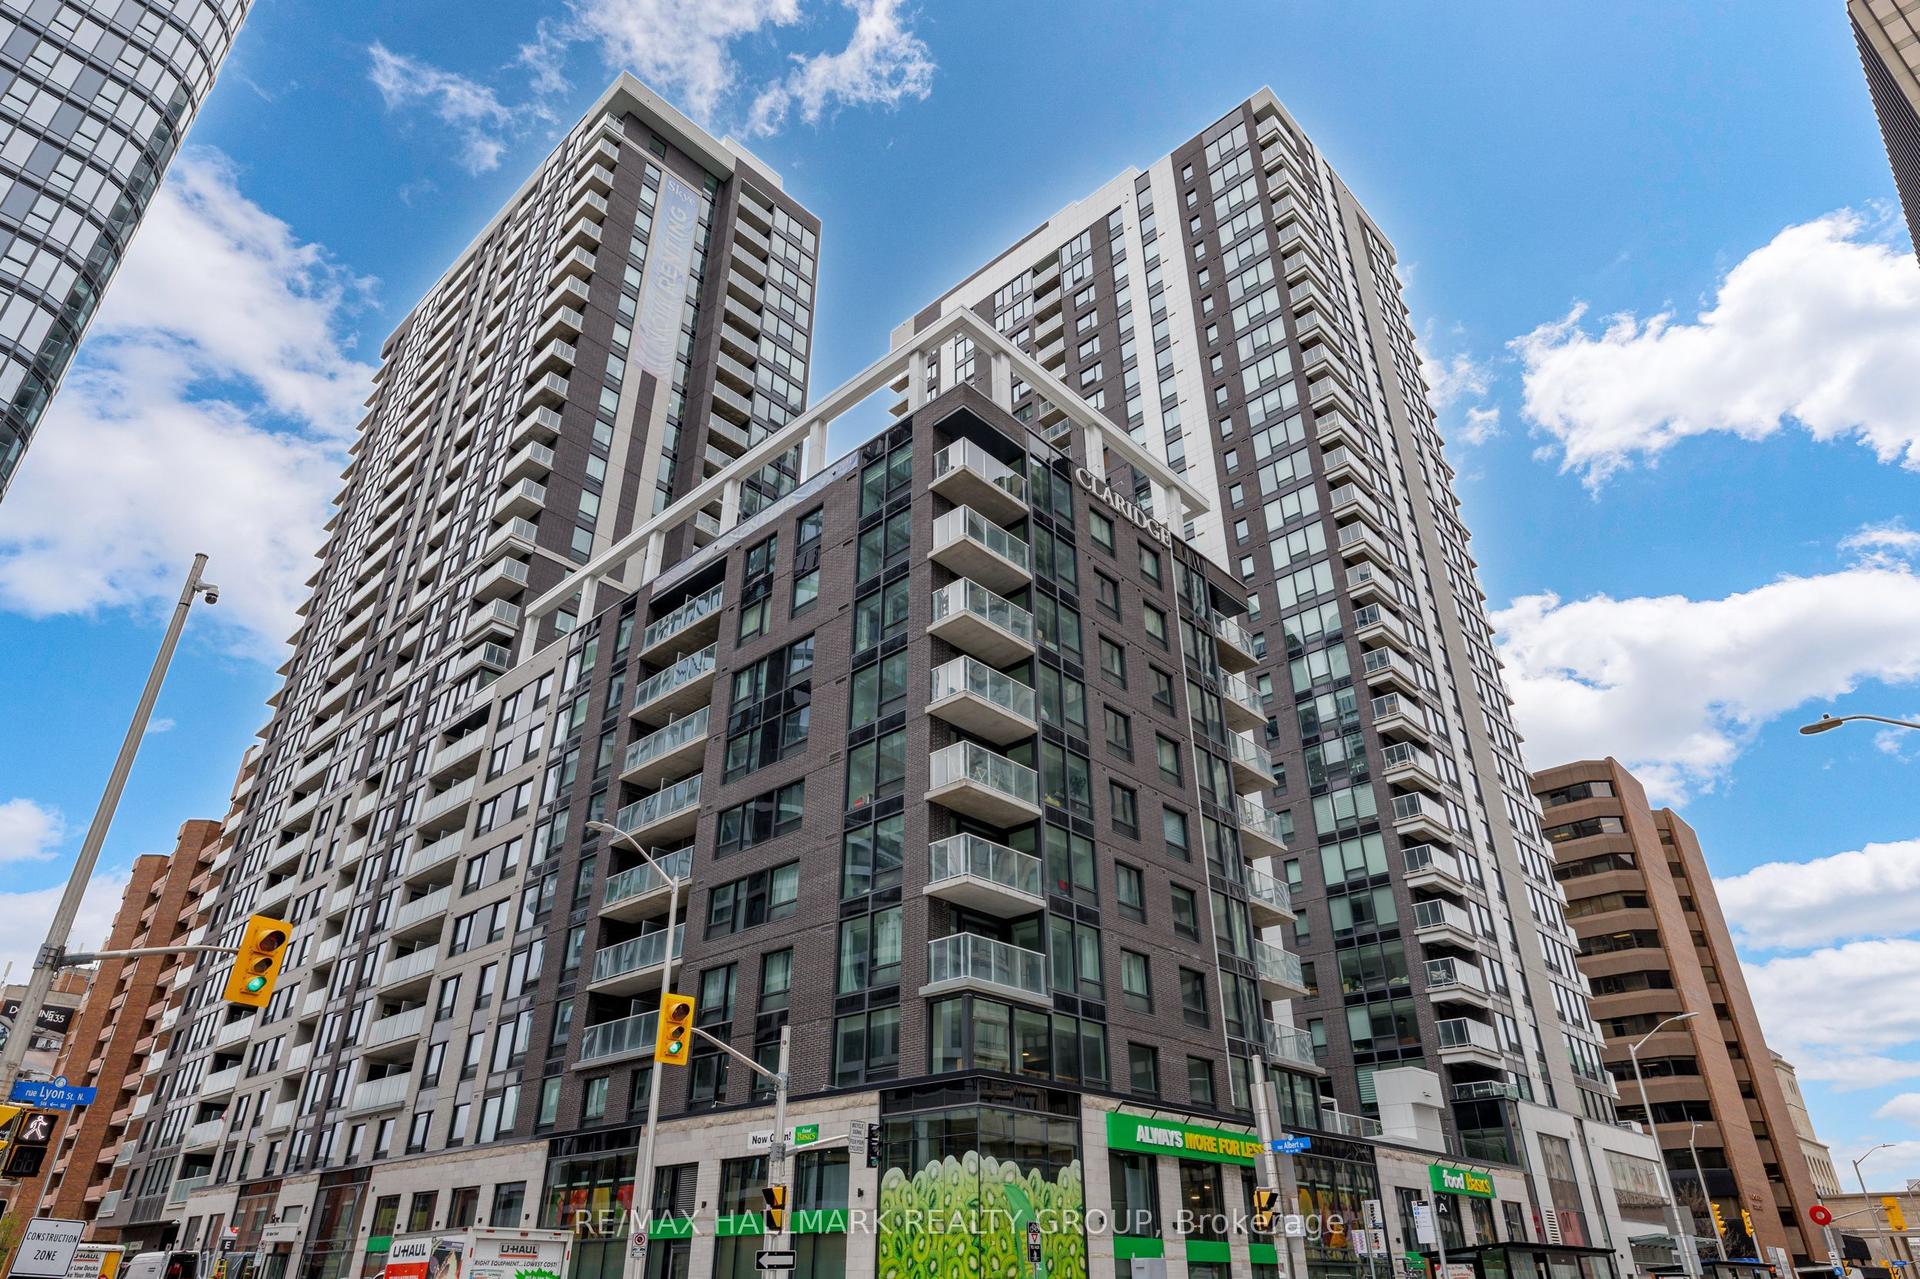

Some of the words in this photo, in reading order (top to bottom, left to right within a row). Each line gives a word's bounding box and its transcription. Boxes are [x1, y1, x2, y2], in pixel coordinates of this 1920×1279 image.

[1075, 467, 1172, 550] CLARIDGE
[25, 1089, 38, 1097] rue
[39, 1086, 65, 1100] Lyon
[752, 1136, 768, 1144] Now
[1136, 1125, 1183, 1148] ALWAYS
[1184, 1131, 1218, 1153] MORE
[1219, 1137, 1241, 1156] FOR
[1240, 1141, 1265, 1158] LESS
[1284, 1141, 1299, 1149] Albert
[1442, 1169, 1465, 1190] food
[1439, 1202, 1448, 1213] A
[26, 1231, 78, 1243] CONSTRUCTION
[225, 1240, 231, 1250] E
[392, 1243, 426, 1258] U-HAUL
[501, 1244, 537, 1254] U-HAUL
[33, 1250, 58, 1261] ZONE
